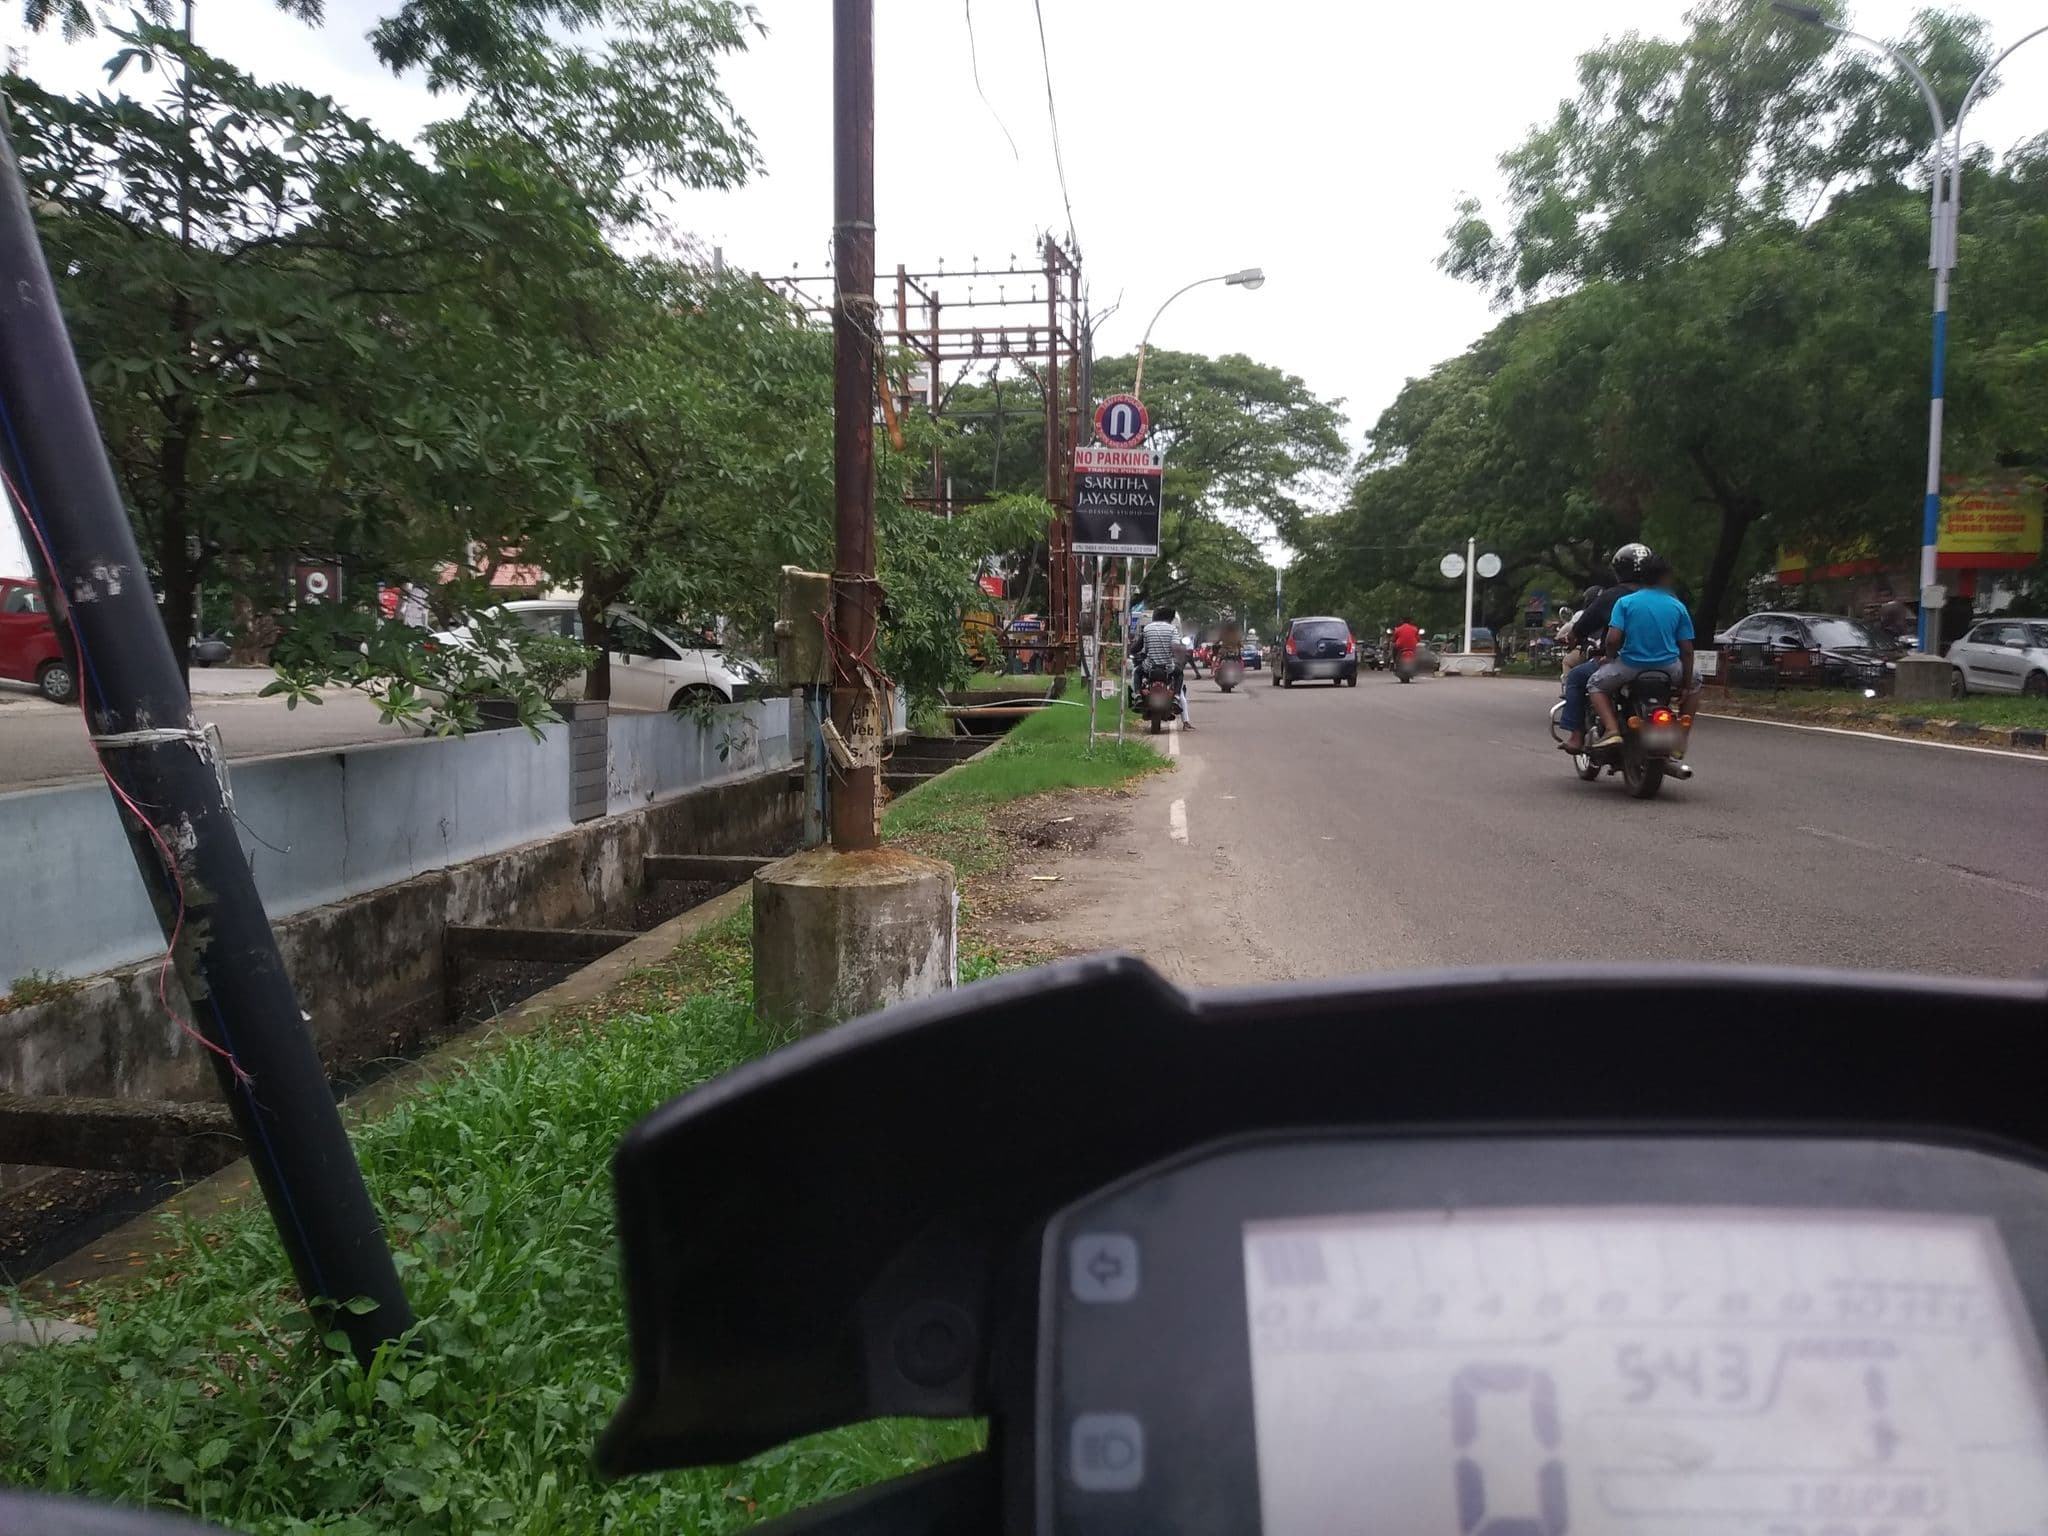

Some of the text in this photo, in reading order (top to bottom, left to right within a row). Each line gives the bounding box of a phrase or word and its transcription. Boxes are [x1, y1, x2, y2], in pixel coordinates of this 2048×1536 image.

[1076, 451, 1150, 466] NO PARKING
[1085, 476, 1149, 490] SARITHA
[1078, 491, 1155, 507] JAYASURYA
